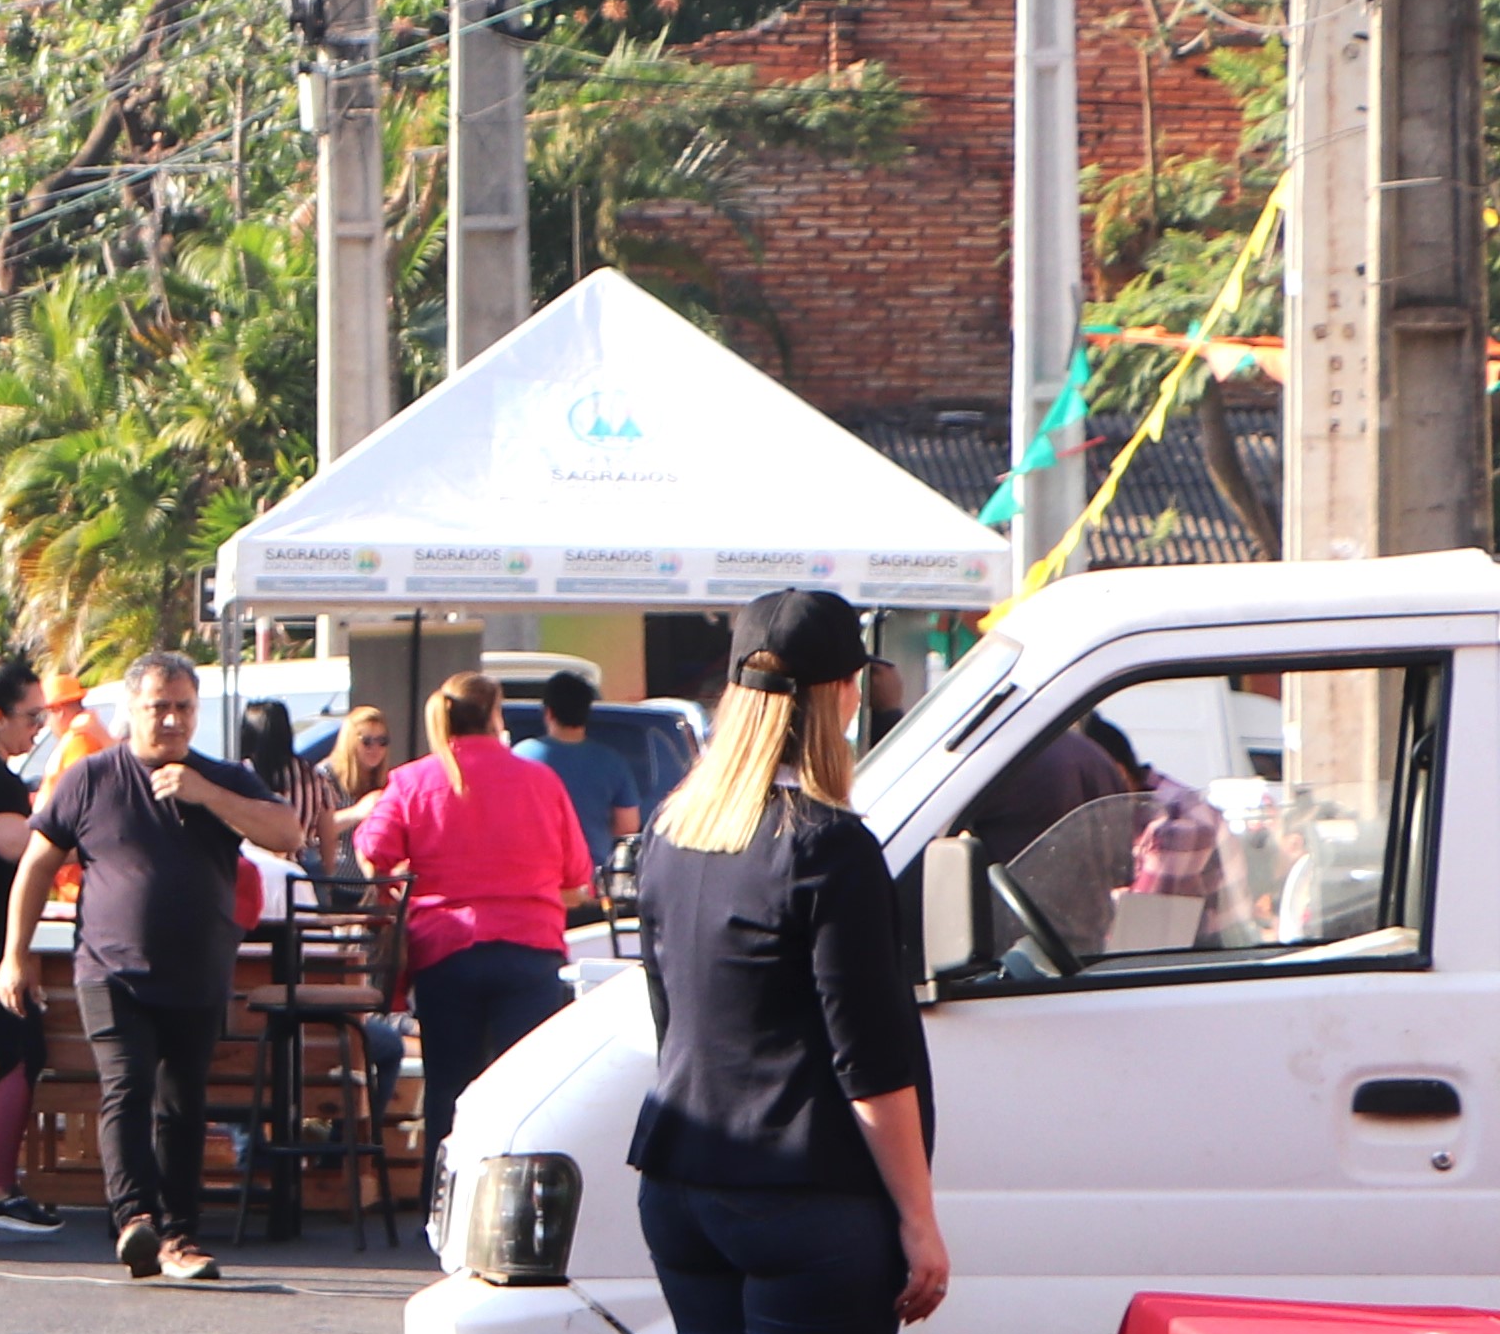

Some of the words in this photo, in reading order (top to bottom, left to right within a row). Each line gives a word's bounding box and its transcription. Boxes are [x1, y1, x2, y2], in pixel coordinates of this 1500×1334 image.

[550, 469, 679, 483] SAGRADOS
[265, 548, 350, 561] SAGRADOS
[414, 548, 502, 562] SAGRADOS
[565, 549, 653, 563] SAGRADOS
[717, 550, 806, 565] SAGRADOS
[869, 553, 958, 568] SAGRADOS
